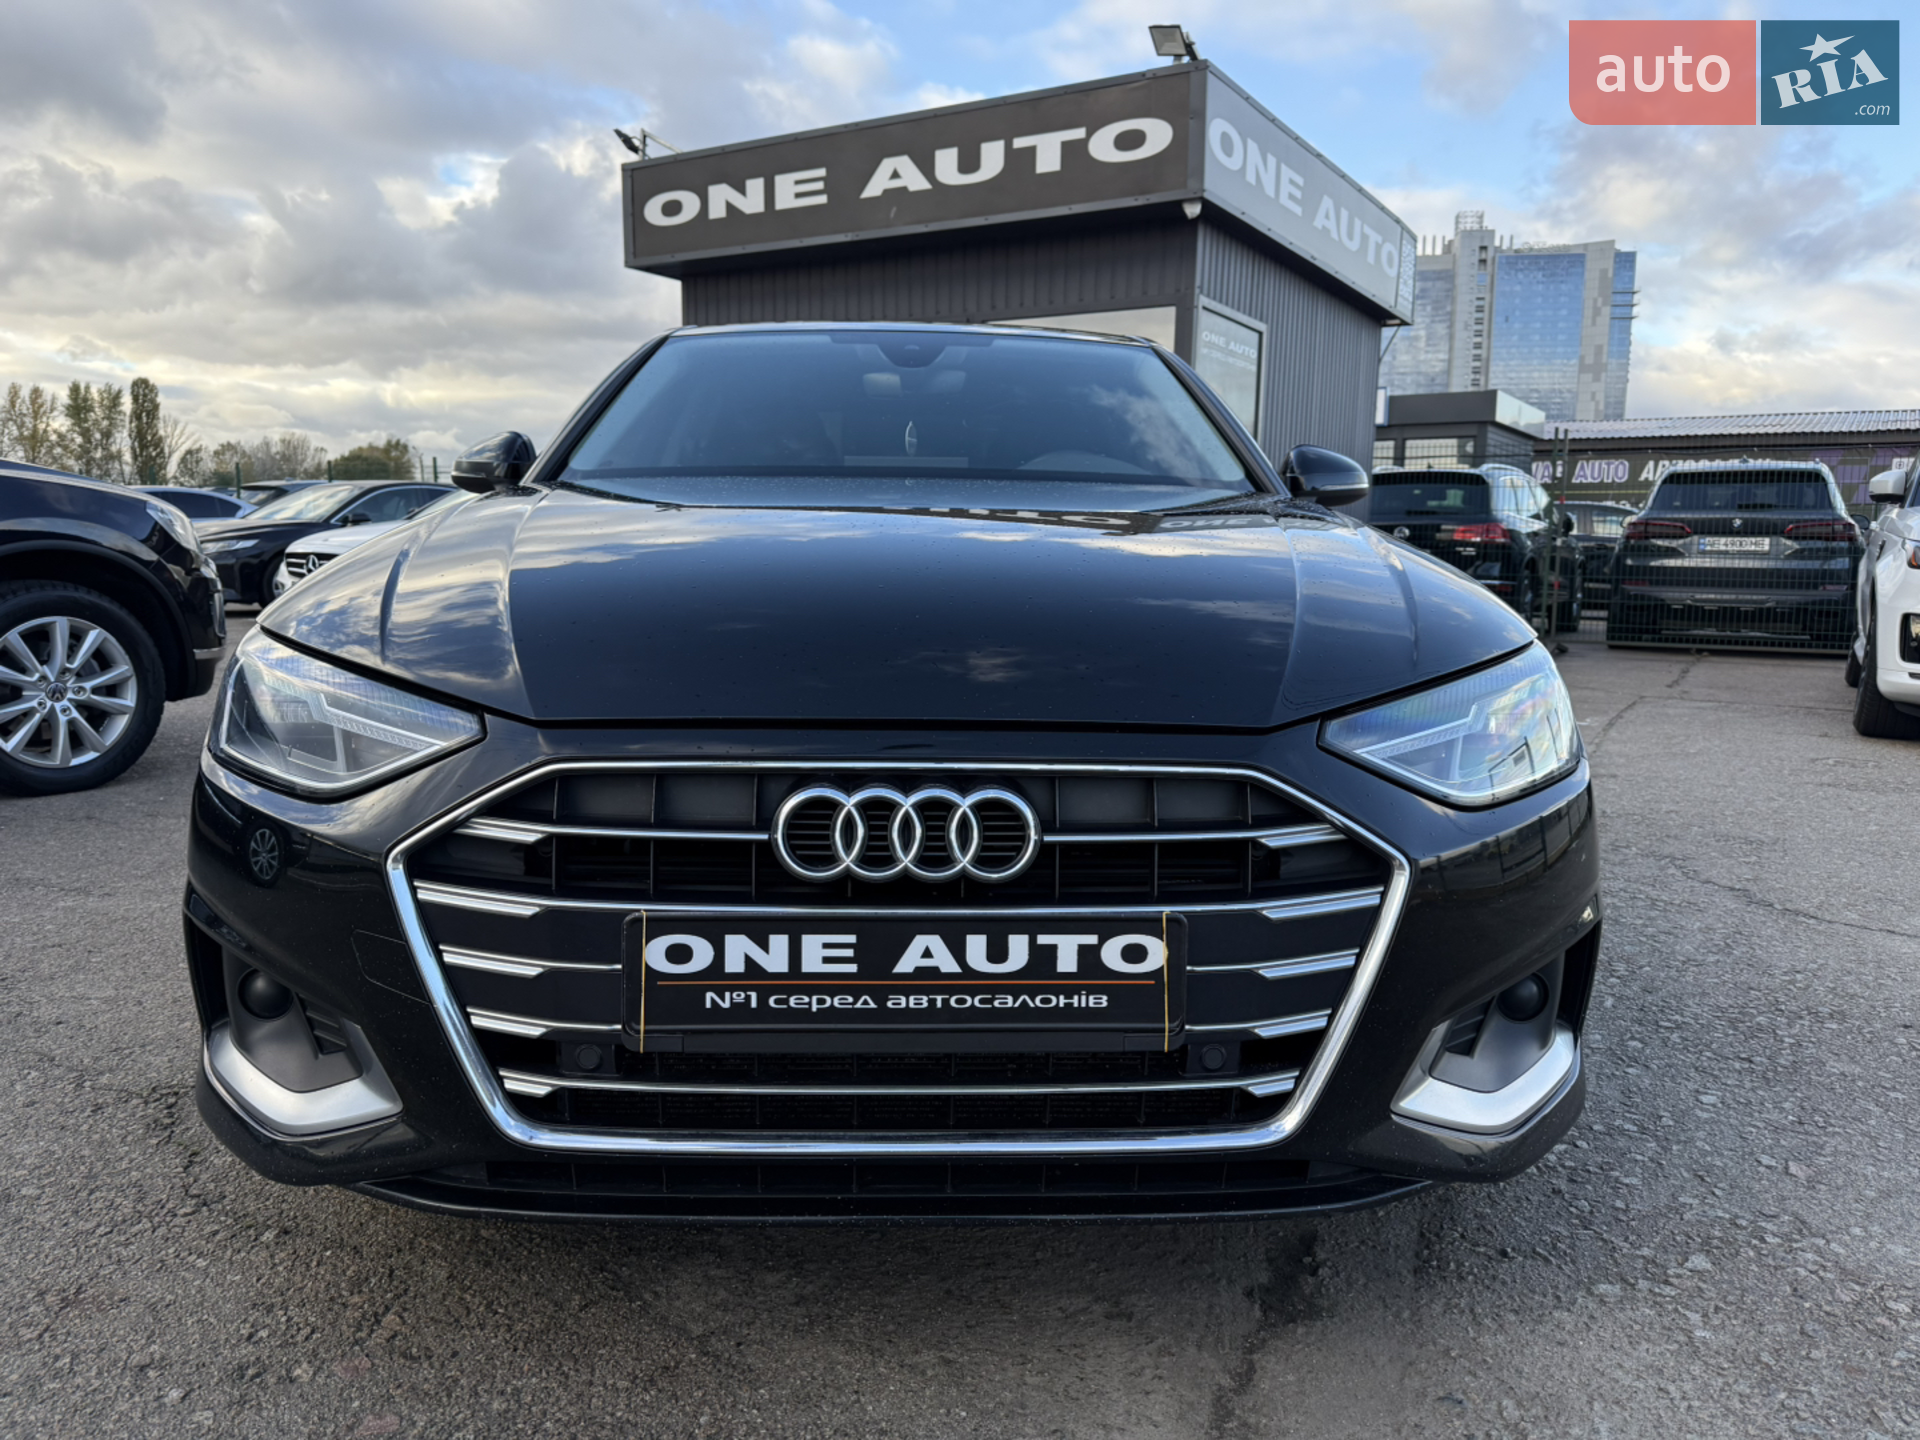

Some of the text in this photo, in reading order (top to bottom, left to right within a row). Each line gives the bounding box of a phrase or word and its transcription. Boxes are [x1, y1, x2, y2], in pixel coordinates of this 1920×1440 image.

[643, 117, 1174, 228] ONE AUTO
[1208, 117, 1399, 278] ONE AUTO
[1202, 331, 1257, 359] ONE AUTO
[1571, 459, 1629, 483] AUTO
[644, 933, 1167, 973] ONE AUTO
[705, 991, 1109, 1012] №1 серед автосалонів
